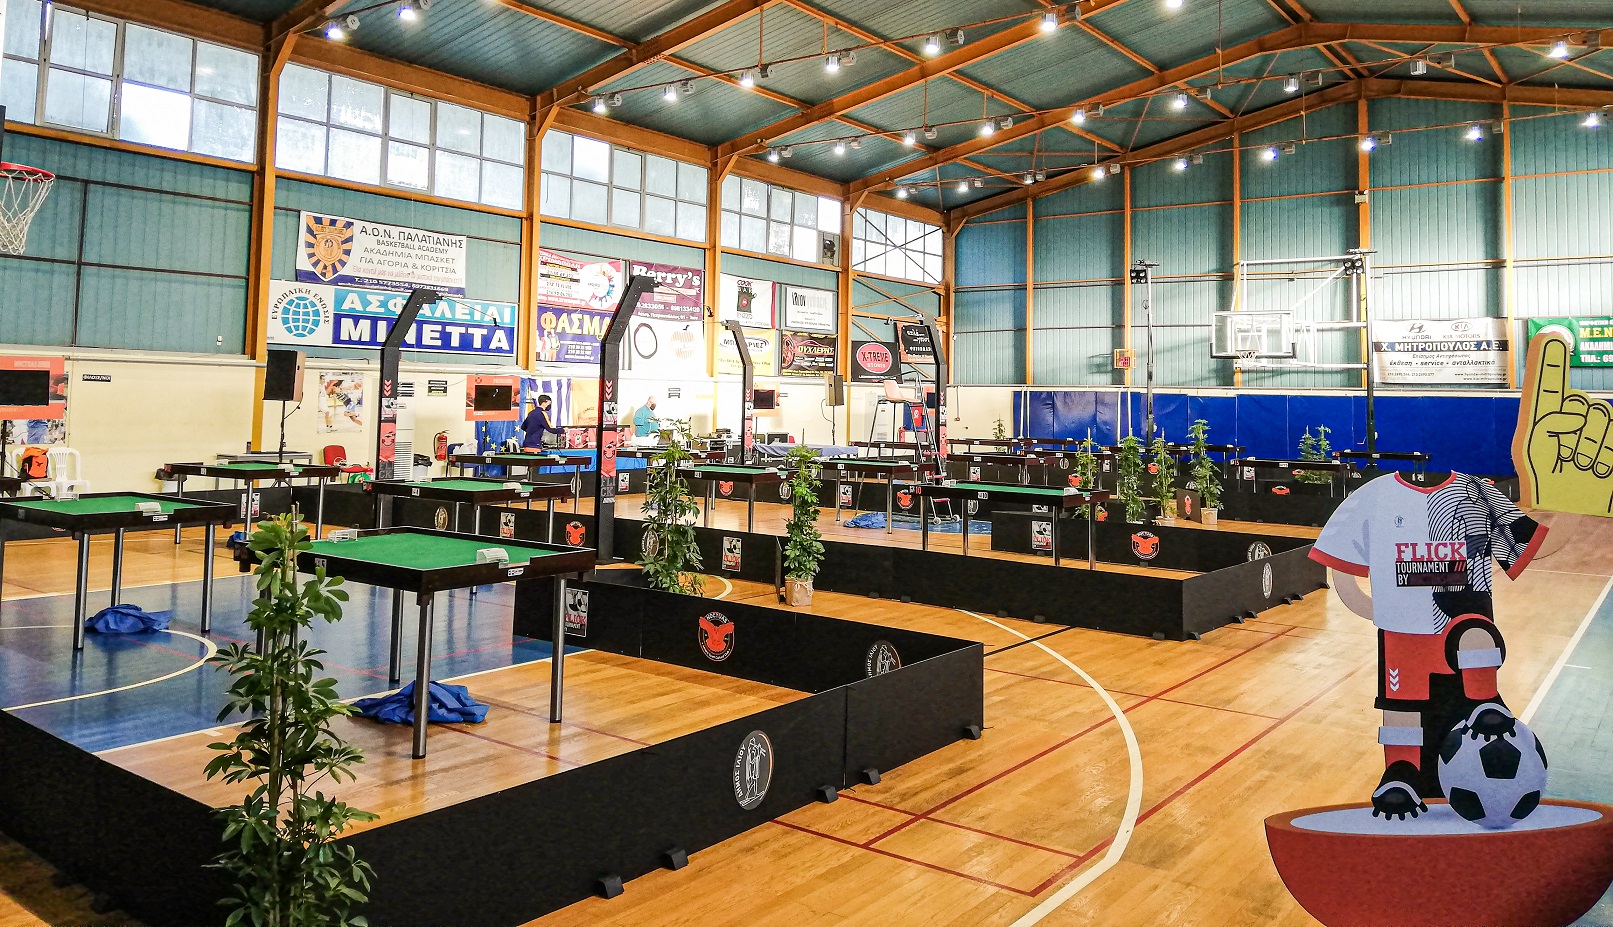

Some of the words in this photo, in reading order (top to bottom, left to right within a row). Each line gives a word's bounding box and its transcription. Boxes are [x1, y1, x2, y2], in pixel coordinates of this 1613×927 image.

[360, 226, 394, 239] Α.Ο.Ν.
[398, 231, 464, 249] ΠΑΛΑΤΙΑΝΗΣ
[377, 239, 416, 251] BASKETBALL
[418, 244, 448, 255] ACADEMY
[359, 256, 374, 265] ΓΙΑ
[376, 259, 409, 269] ΑΓΟΡΙΑ
[420, 264, 457, 275] ΚΟΡΙΤΣΙΑ
[363, 247, 413, 259] ΑΚΑΔΗΜΙΑ
[415, 253, 456, 265] ΜΠΑΣΚΕΤ
[313, 293, 330, 324] ΕΝΩΣΙΣ
[1395, 341, 1478, 351] ΜΗΤΡΟΠΟΥΛΟΣ
[1480, 340, 1502, 350] Α.Ε.
[1395, 542, 1466, 561] FLICK
[1396, 561, 1450, 573] TOURNAMENT
[1398, 574, 1409, 585] BY
[735, 743, 746, 768] ΙΛΙΟΥ
[734, 770, 744, 798] ΔΗΜΟΣ
